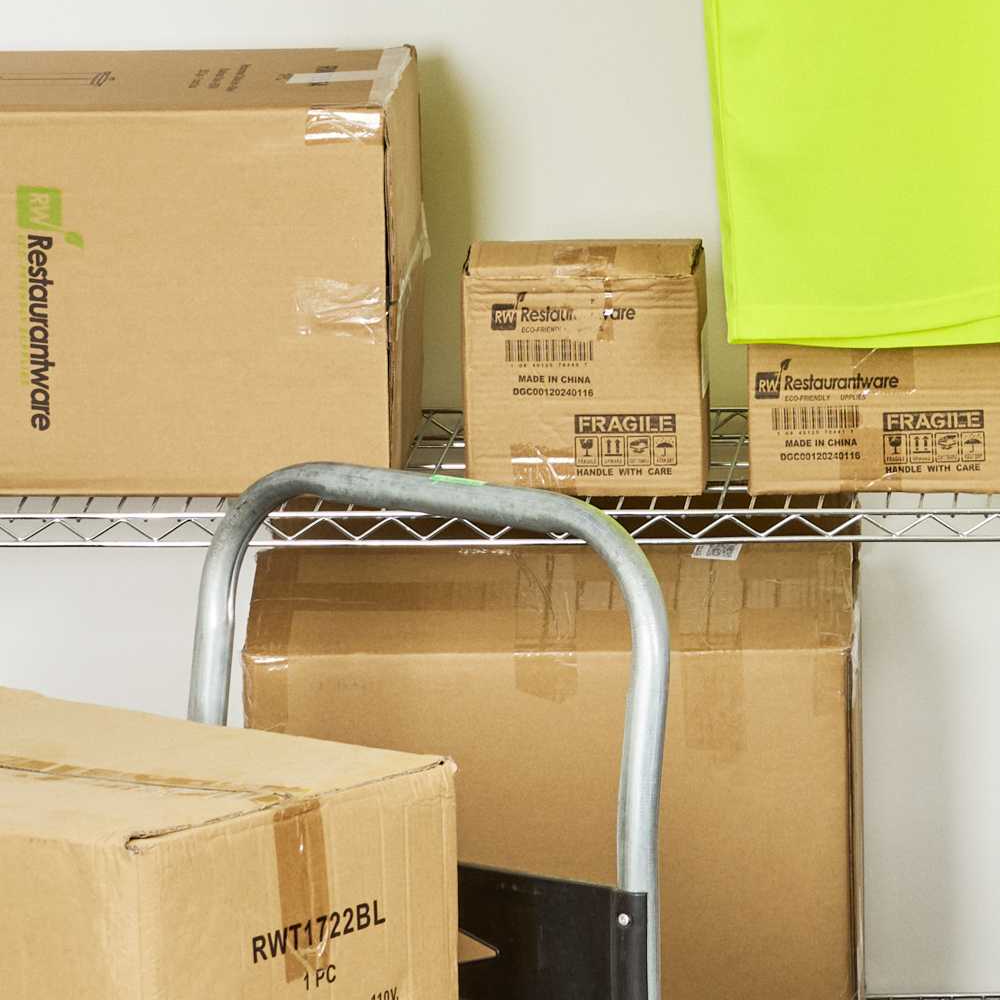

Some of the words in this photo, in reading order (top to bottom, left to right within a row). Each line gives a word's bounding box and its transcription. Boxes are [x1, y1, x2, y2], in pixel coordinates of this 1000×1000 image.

[494, 309, 516, 325] RW
[27, 234, 56, 432] Restaurantware
[518, 375, 545, 383] MADE
[548, 375, 558, 383] IN
[561, 375, 591, 384] CHINA
[758, 379, 779, 393] RW
[784, 373, 899, 391] Restaurantware
[579, 415, 673, 433] FRAGILE
[887, 411, 981, 430] FRAGILE
[785, 439, 812, 448] MADE
[815, 439, 825, 447] IN
[828, 438, 858, 447] CHINA
[576, 467, 614, 477] HANDLE
[618, 467, 642, 476] WITH
[647, 467, 673, 476] CARE
[886, 464, 922, 474] HANDLE
[927, 464, 950, 473] WITH
[956, 463, 981, 472] CARE
[252, 900, 386, 964] RWT1722BL
[303, 972, 311, 991] 1
[315, 964, 337, 989] PC
